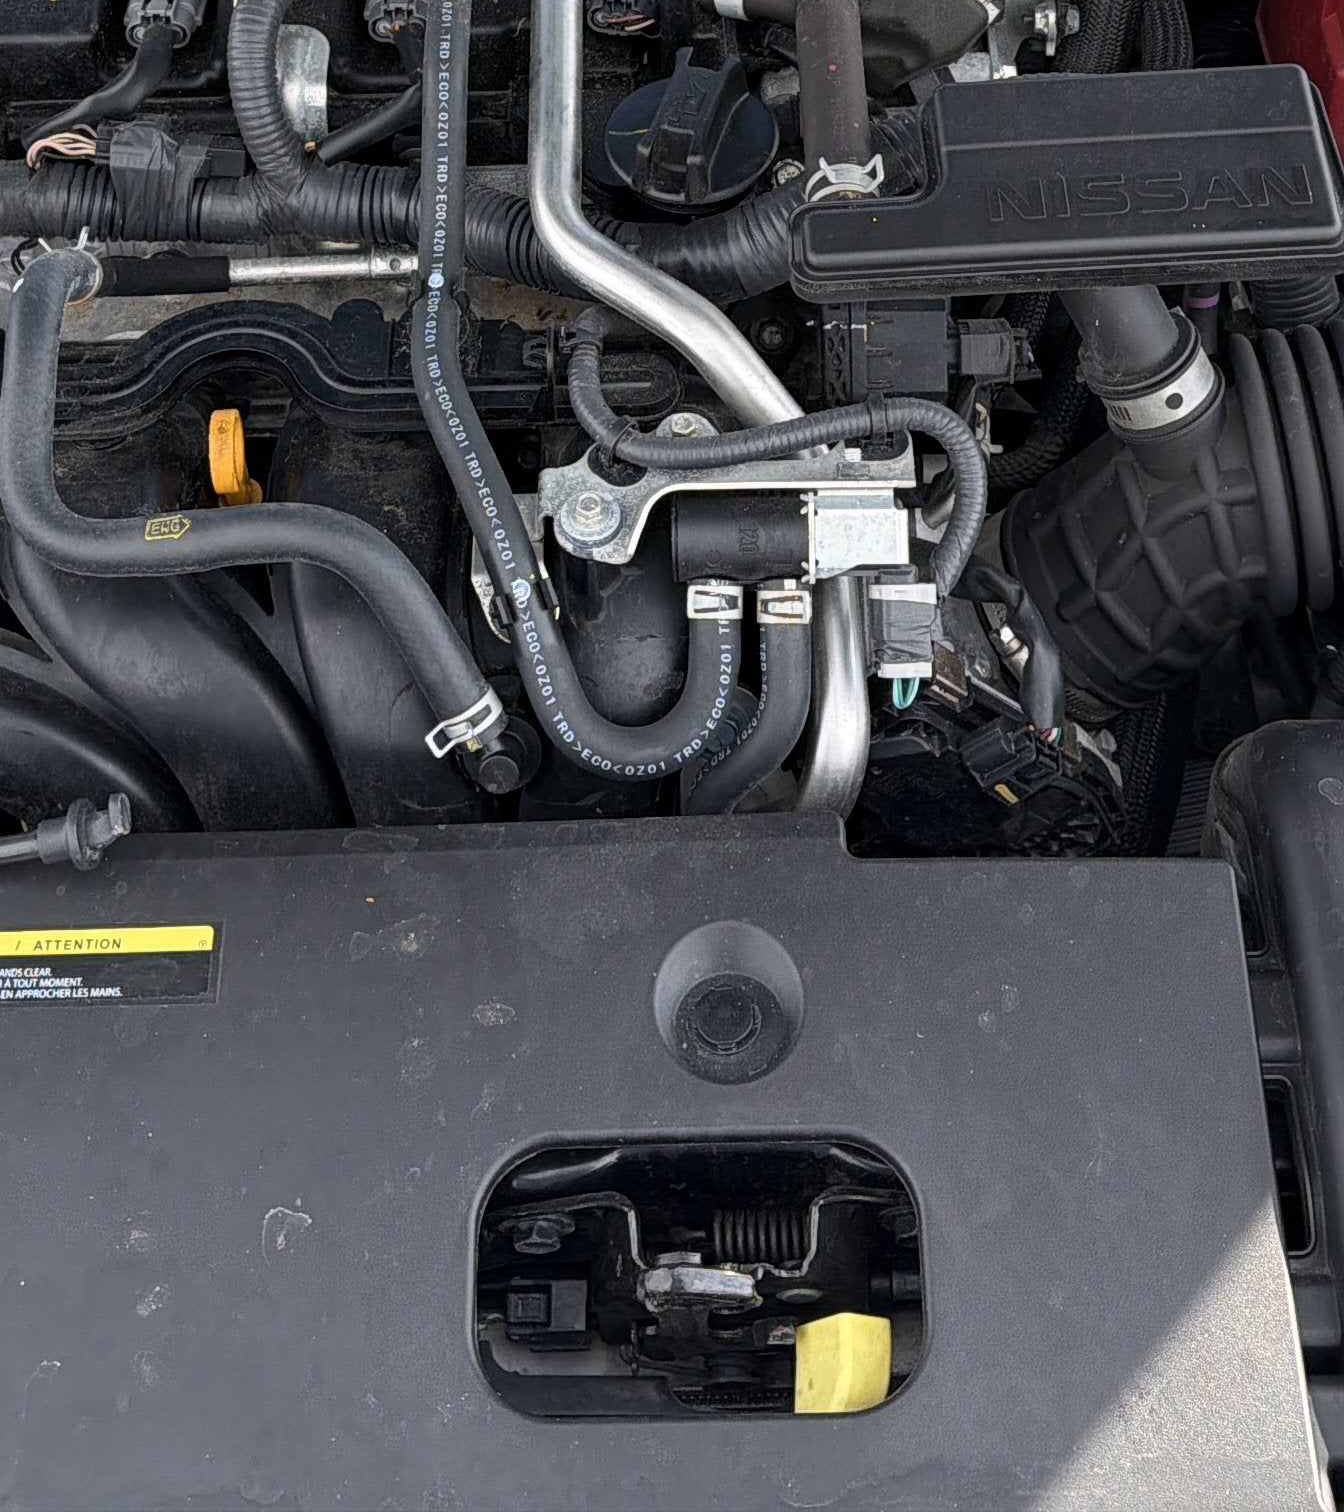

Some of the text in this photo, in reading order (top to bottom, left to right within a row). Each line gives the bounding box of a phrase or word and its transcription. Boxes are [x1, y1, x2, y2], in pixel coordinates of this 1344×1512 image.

[987, 163, 1314, 222] NISSAN
[15, 940, 21, 951] /
[33, 938, 122, 951] ATTENTION
[13, 979, 37, 987] TOUT
[0, 991, 14, 999] EN
[14, 989, 71, 999] APPROCHER
[72, 989, 89, 998] LES
